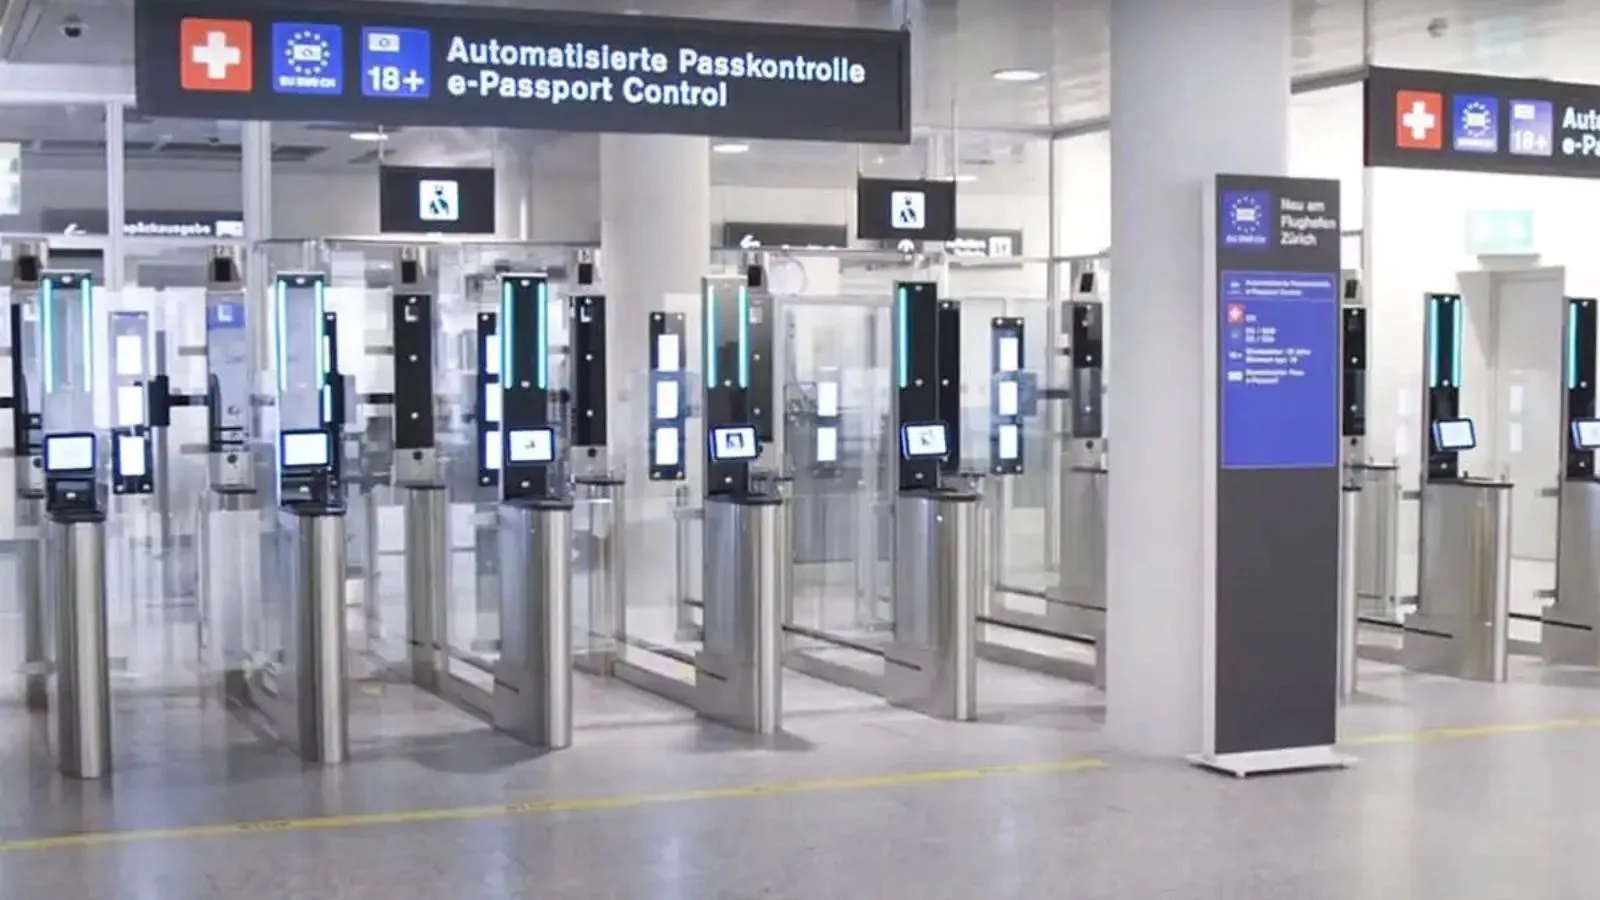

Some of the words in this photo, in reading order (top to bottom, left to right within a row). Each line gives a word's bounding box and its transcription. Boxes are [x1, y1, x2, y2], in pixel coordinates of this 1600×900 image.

[446, 35, 669, 74] Automatisierte
[679, 48, 867, 85] Passkontrolle
[367, 64, 425, 94] 18+
[447, 70, 614, 105] e-Passport
[622, 75, 728, 107] Control
